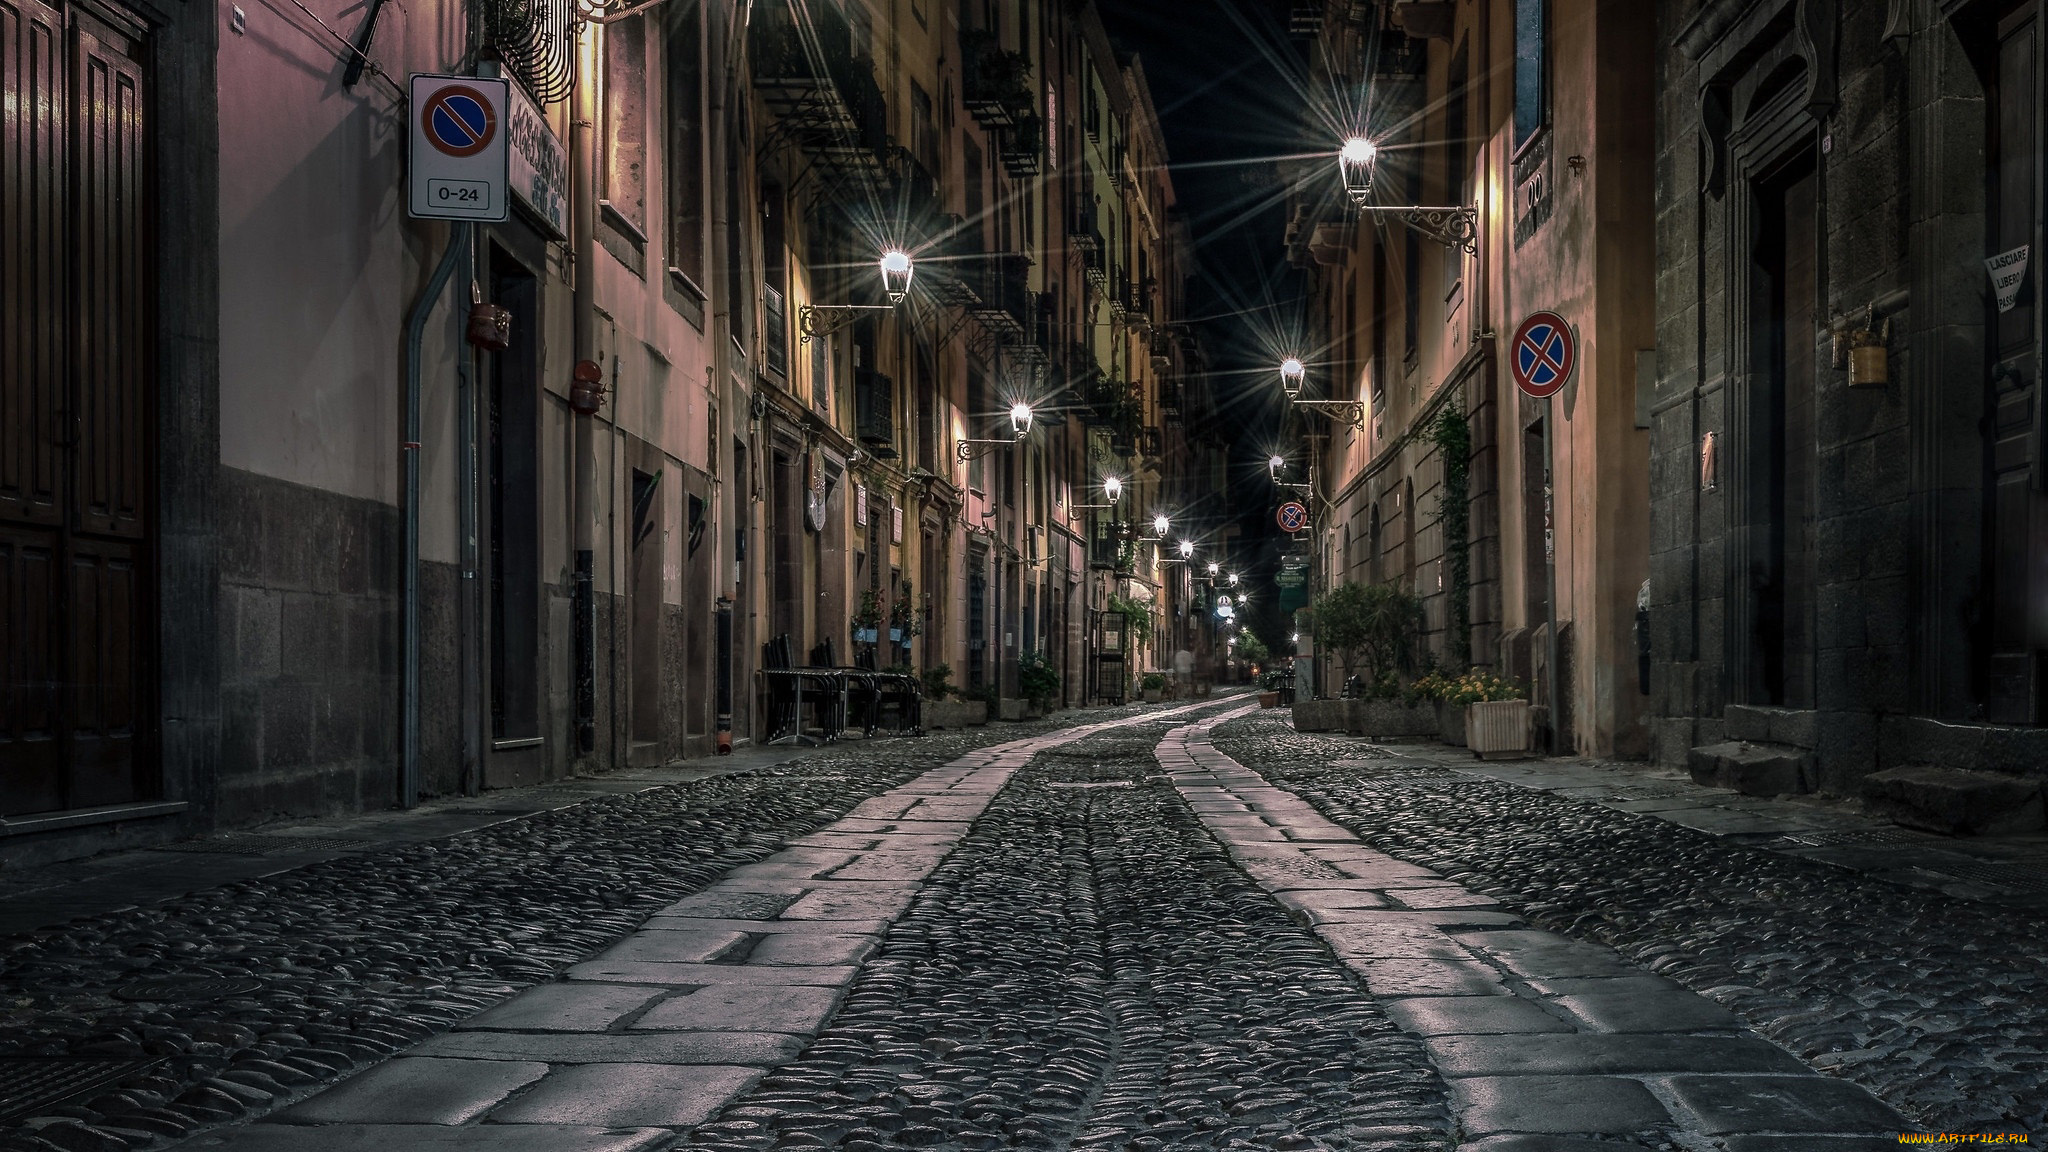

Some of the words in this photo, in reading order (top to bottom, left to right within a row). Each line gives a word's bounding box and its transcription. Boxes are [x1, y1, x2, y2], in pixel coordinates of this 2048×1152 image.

[439, 187, 479, 202] 0-24
[1989, 249, 2026, 271] LASCIARE
[1997, 272, 2020, 289] LIBERO
